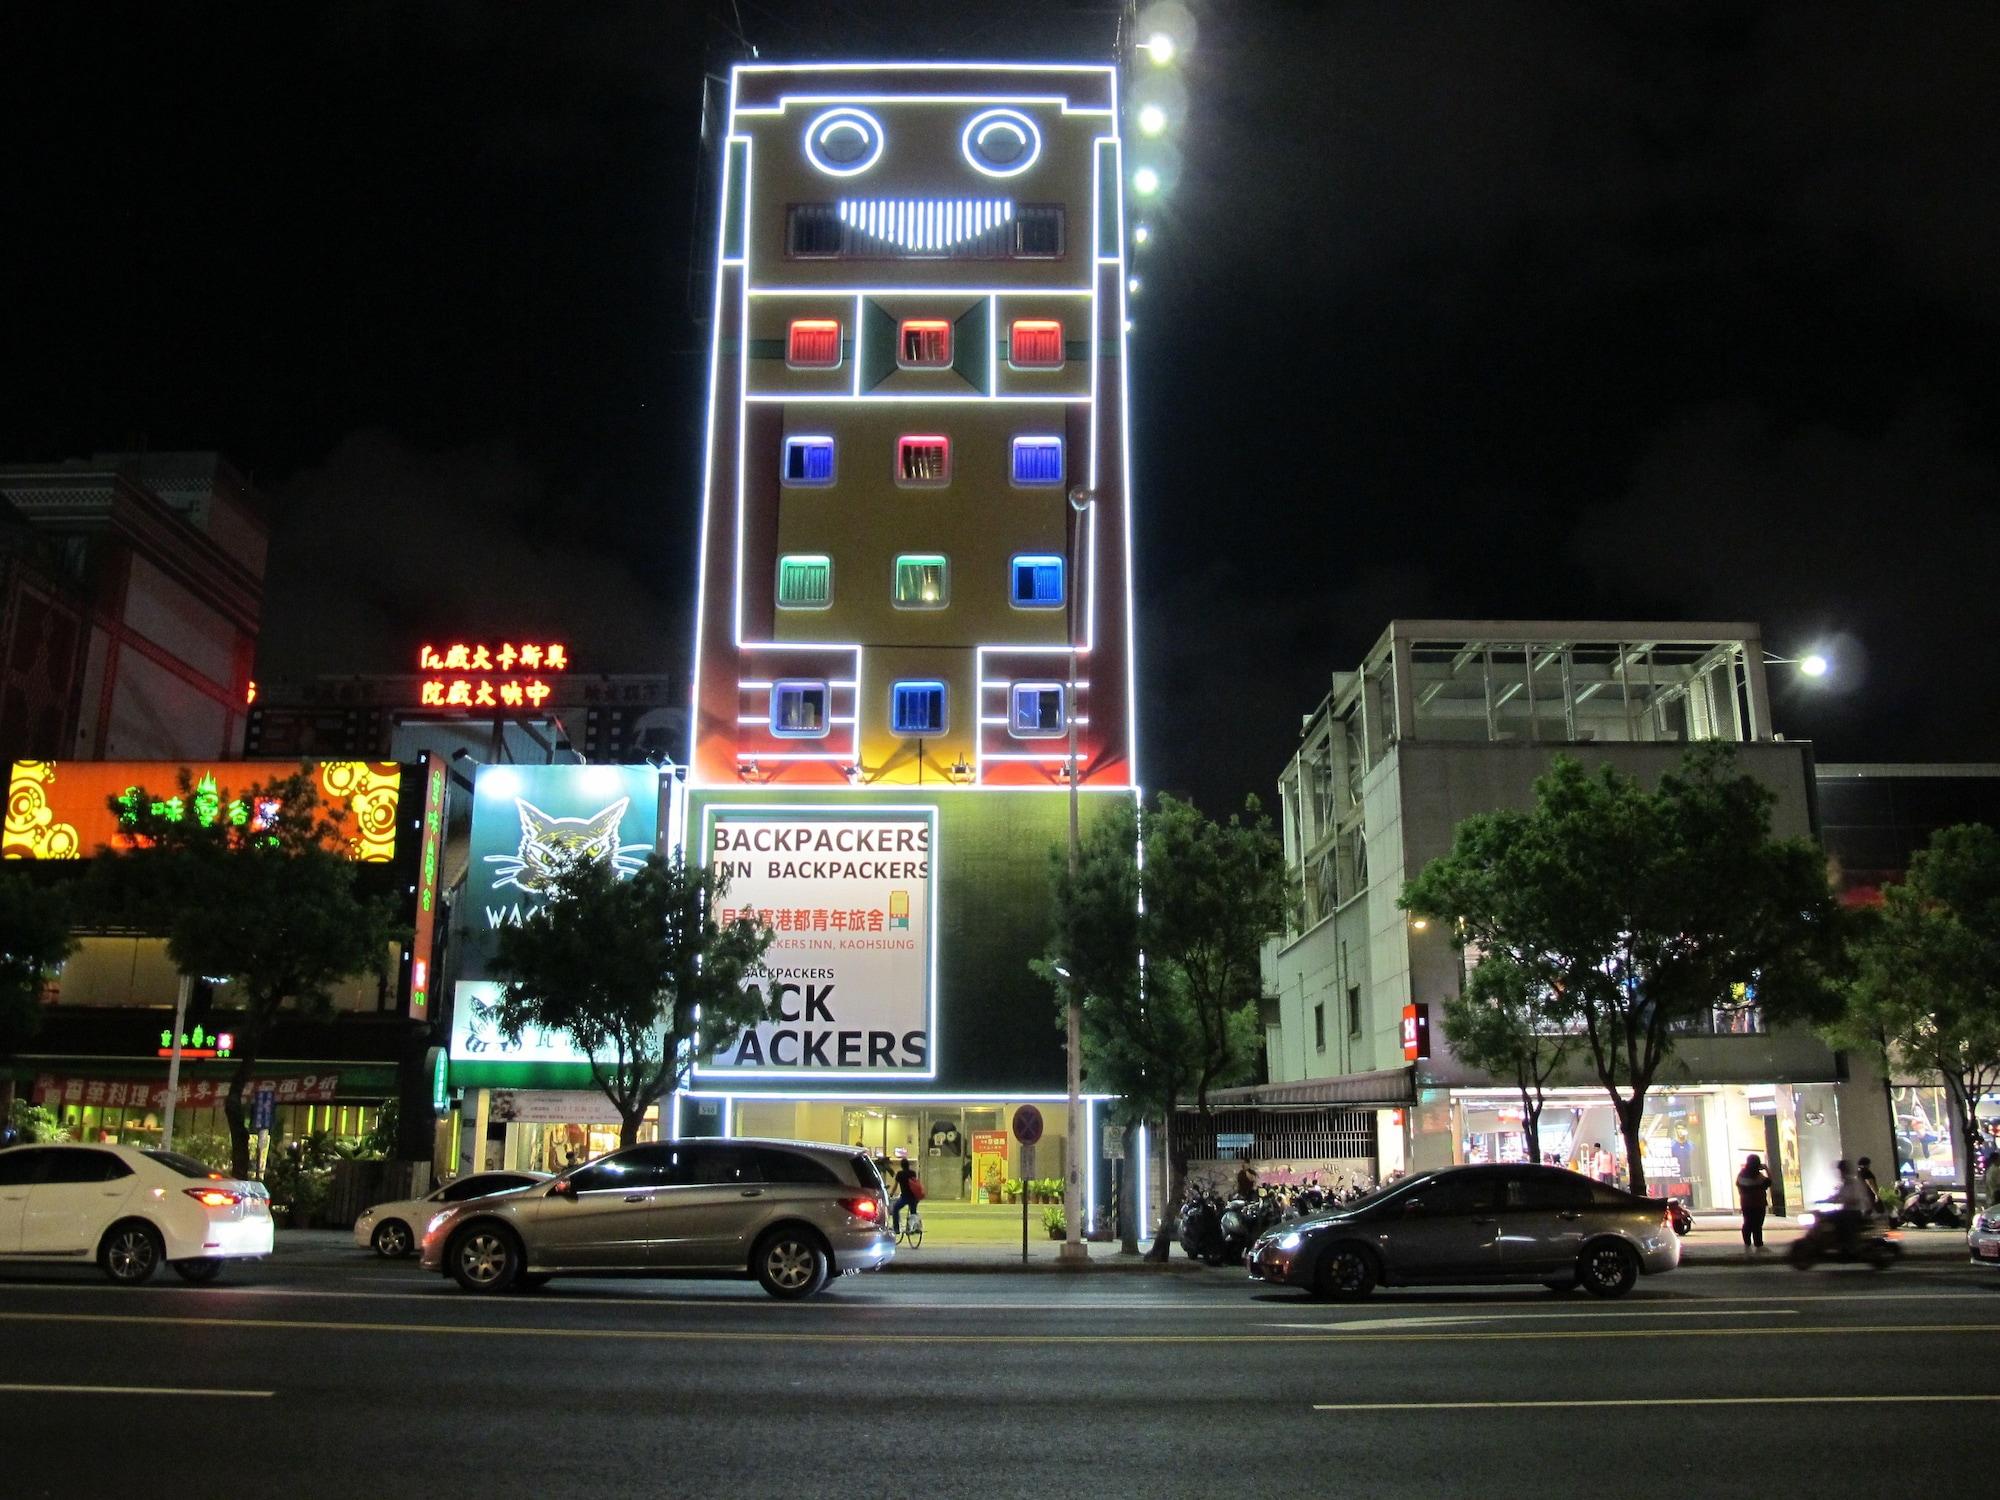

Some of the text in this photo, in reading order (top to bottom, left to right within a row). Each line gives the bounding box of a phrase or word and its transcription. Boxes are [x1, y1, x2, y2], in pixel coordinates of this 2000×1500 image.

[714, 828, 928, 852] BACKPACKERS
[713, 861, 928, 879] INN BACKPACKERS
[809, 939, 836, 950] INN,
[840, 939, 914, 950] KAOHSIUNG
[746, 983, 836, 1022] ACK
[711, 1029, 927, 1067] ACKERS
